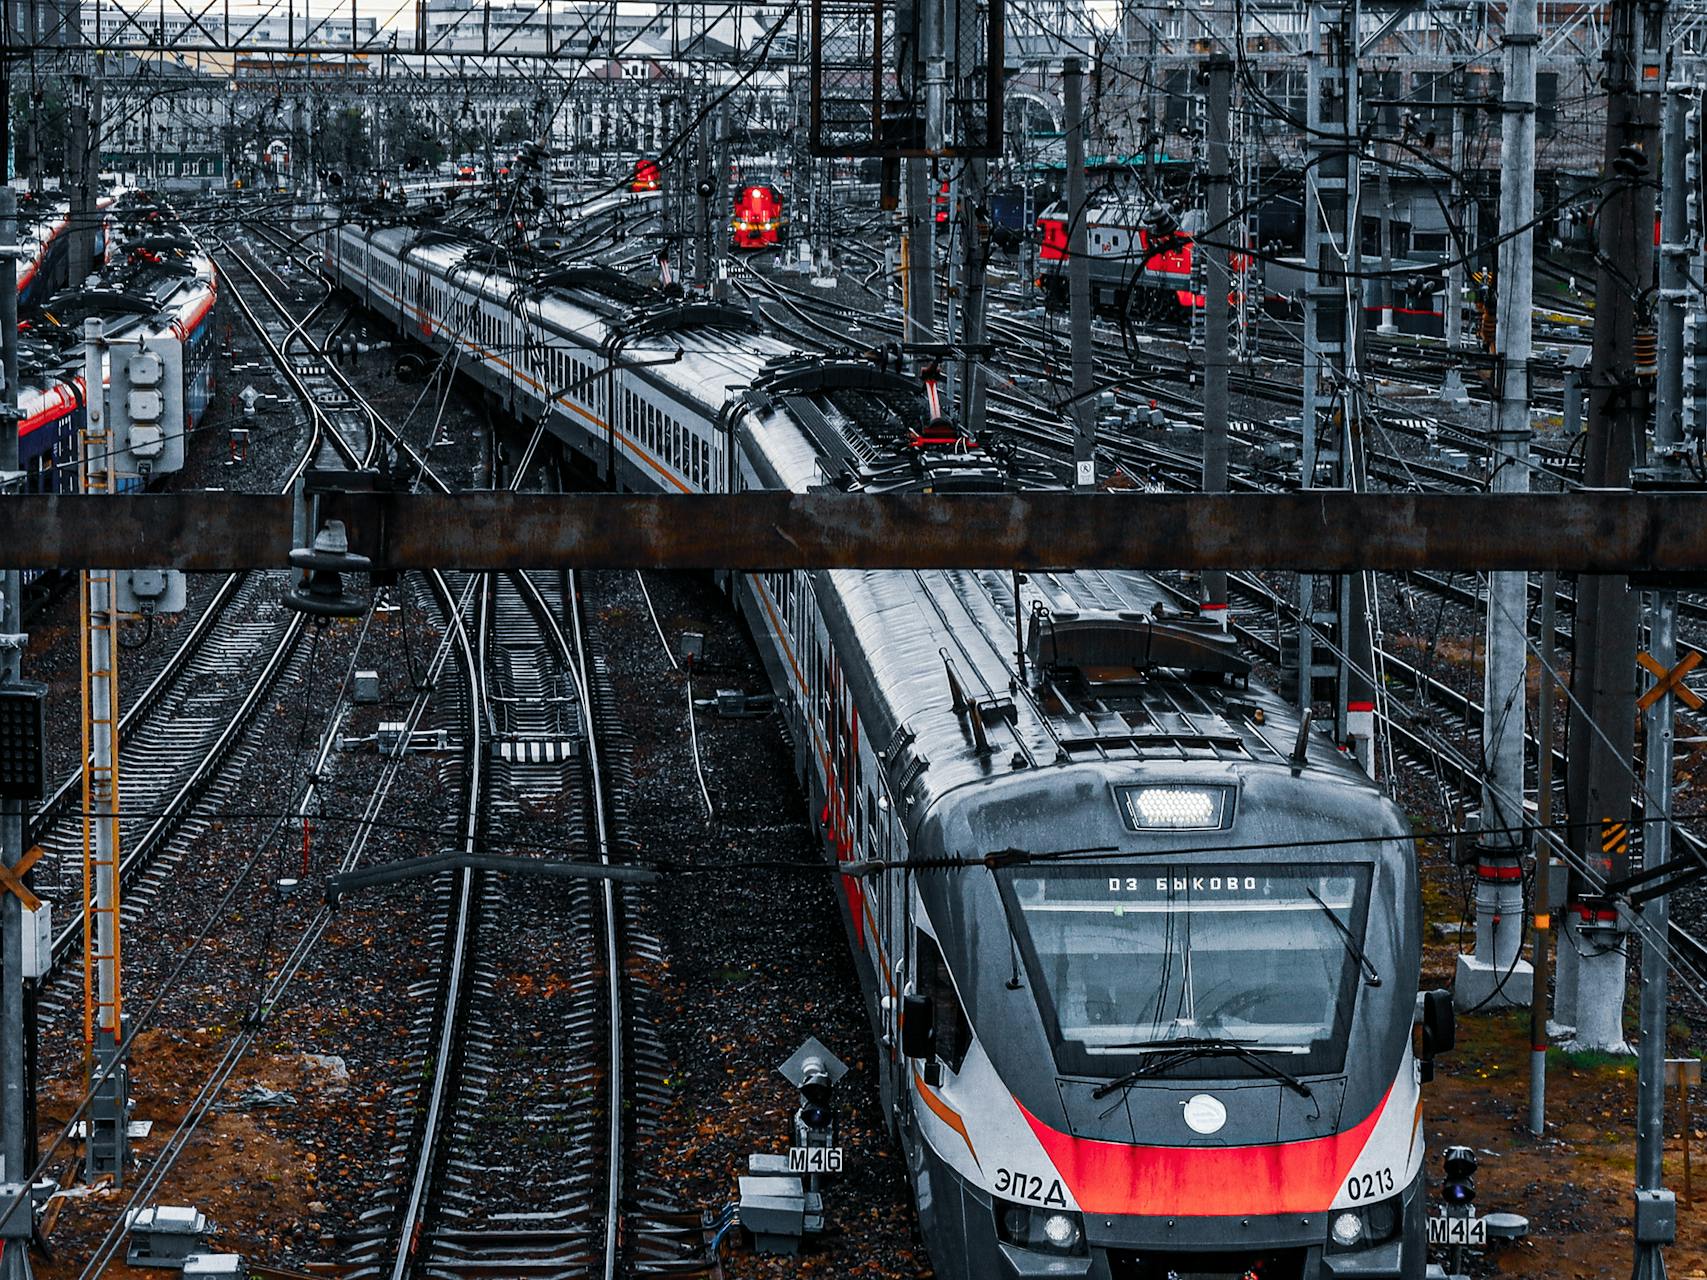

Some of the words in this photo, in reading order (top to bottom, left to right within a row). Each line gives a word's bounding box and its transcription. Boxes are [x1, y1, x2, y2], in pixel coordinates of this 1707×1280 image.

[1156, 876, 1256, 891] БЫКОВО
[994, 1168, 1067, 1208] ЭП2Д
[1348, 1167, 1394, 1200] 0213
